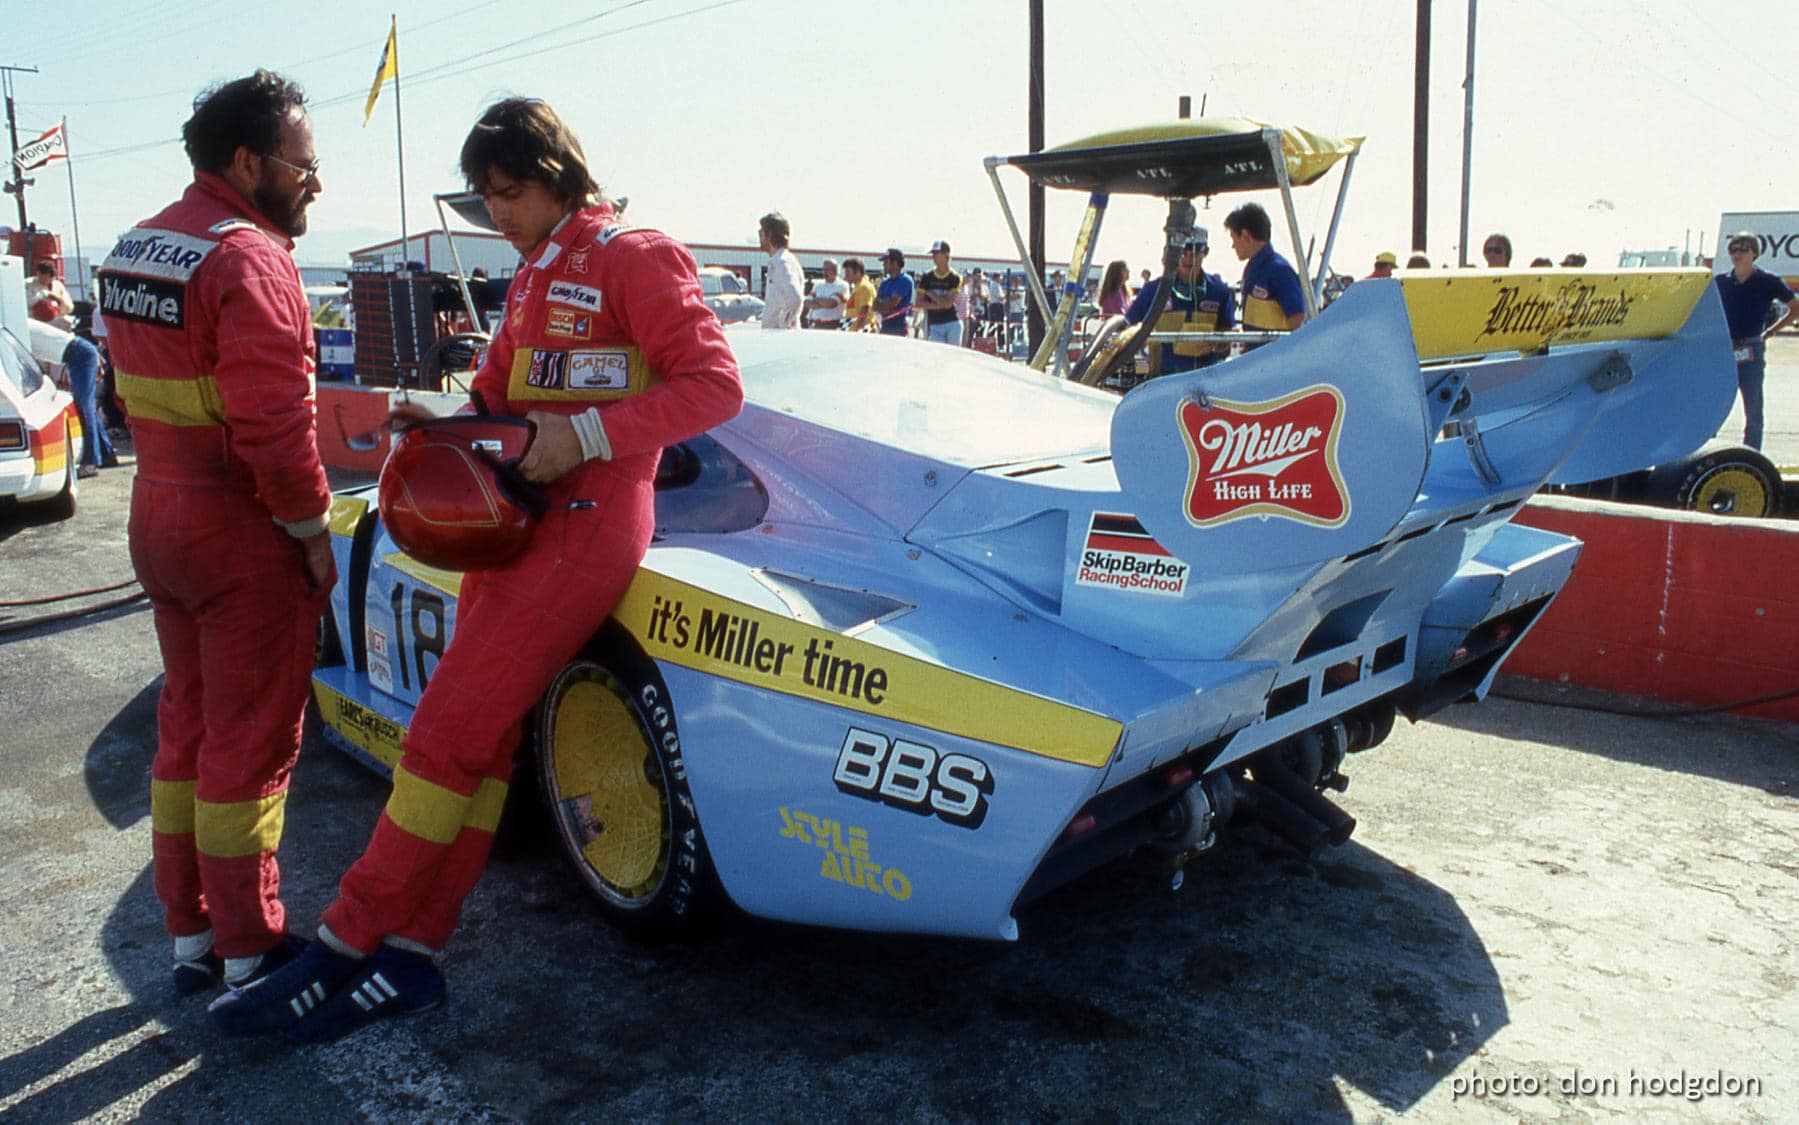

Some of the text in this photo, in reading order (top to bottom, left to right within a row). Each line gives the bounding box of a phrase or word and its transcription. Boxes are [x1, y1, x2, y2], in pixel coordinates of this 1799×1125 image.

[1223, 161, 1263, 176] ATL
[572, 355, 626, 370] CAMEL
[1199, 419, 1322, 474] Miller
[1214, 479, 1313, 500] HIGH LIFE
[390, 581, 446, 692] 18
[647, 595, 888, 705] it's Miller time
[833, 727, 994, 828] BBS
